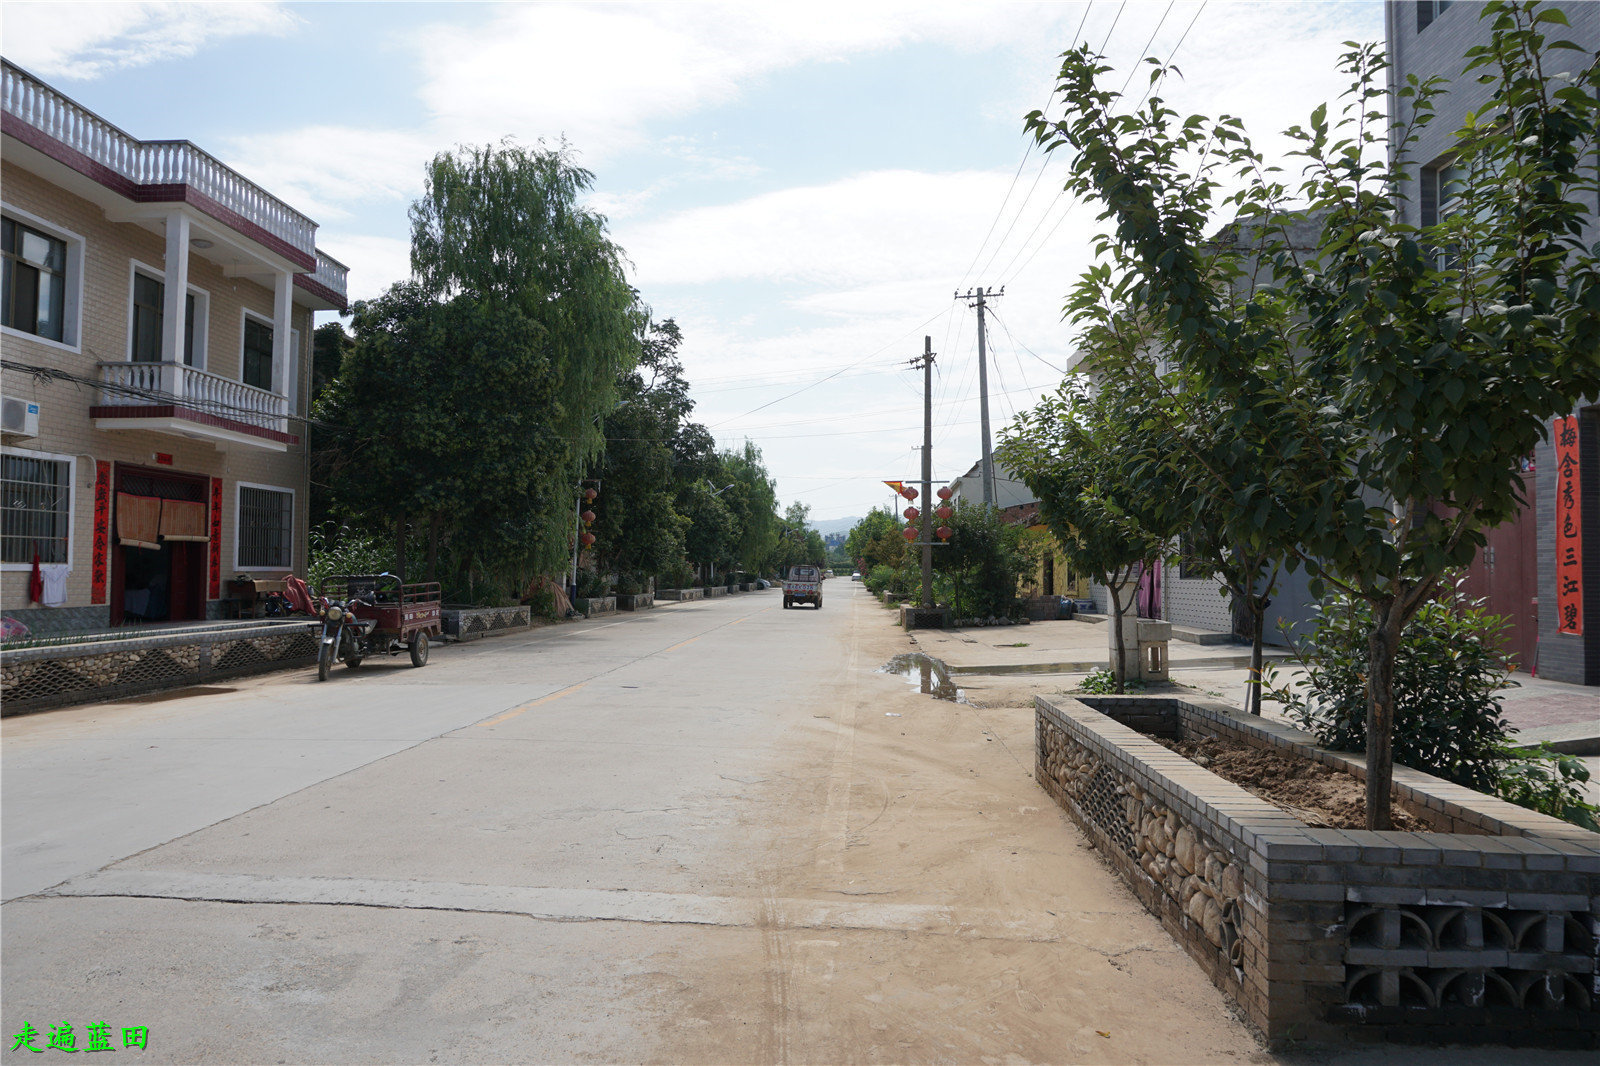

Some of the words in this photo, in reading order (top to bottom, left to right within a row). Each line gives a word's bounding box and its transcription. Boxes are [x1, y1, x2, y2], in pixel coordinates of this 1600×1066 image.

[1560, 422, 1579, 630] 梅含秀色三江碧
